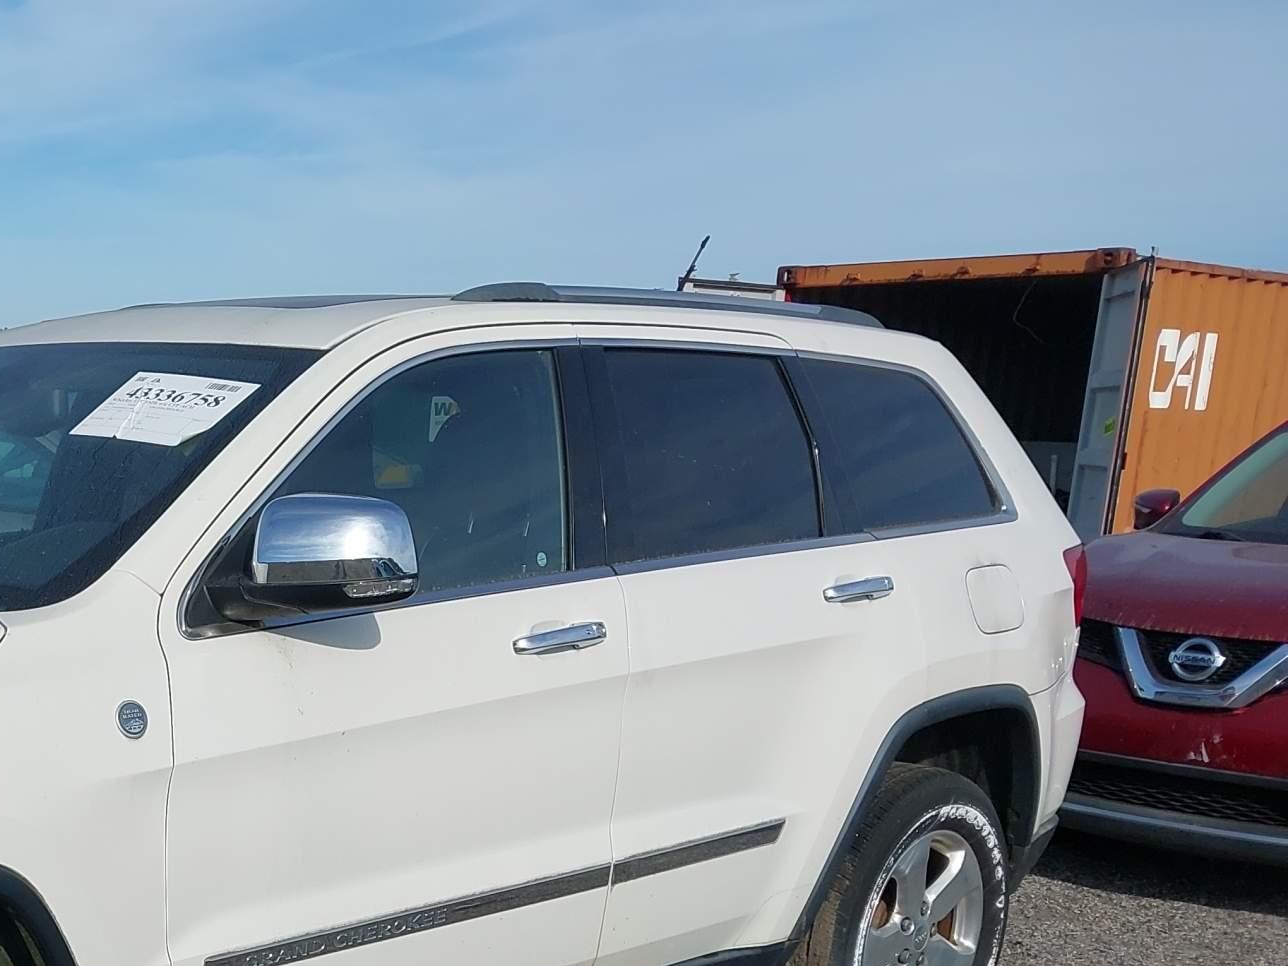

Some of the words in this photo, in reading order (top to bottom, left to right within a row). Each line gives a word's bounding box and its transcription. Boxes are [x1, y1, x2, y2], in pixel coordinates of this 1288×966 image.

[1149, 329, 1219, 411] CAI
[126, 387, 226, 408] 43336758
[333, 908, 449, 948] CHEROKEE
